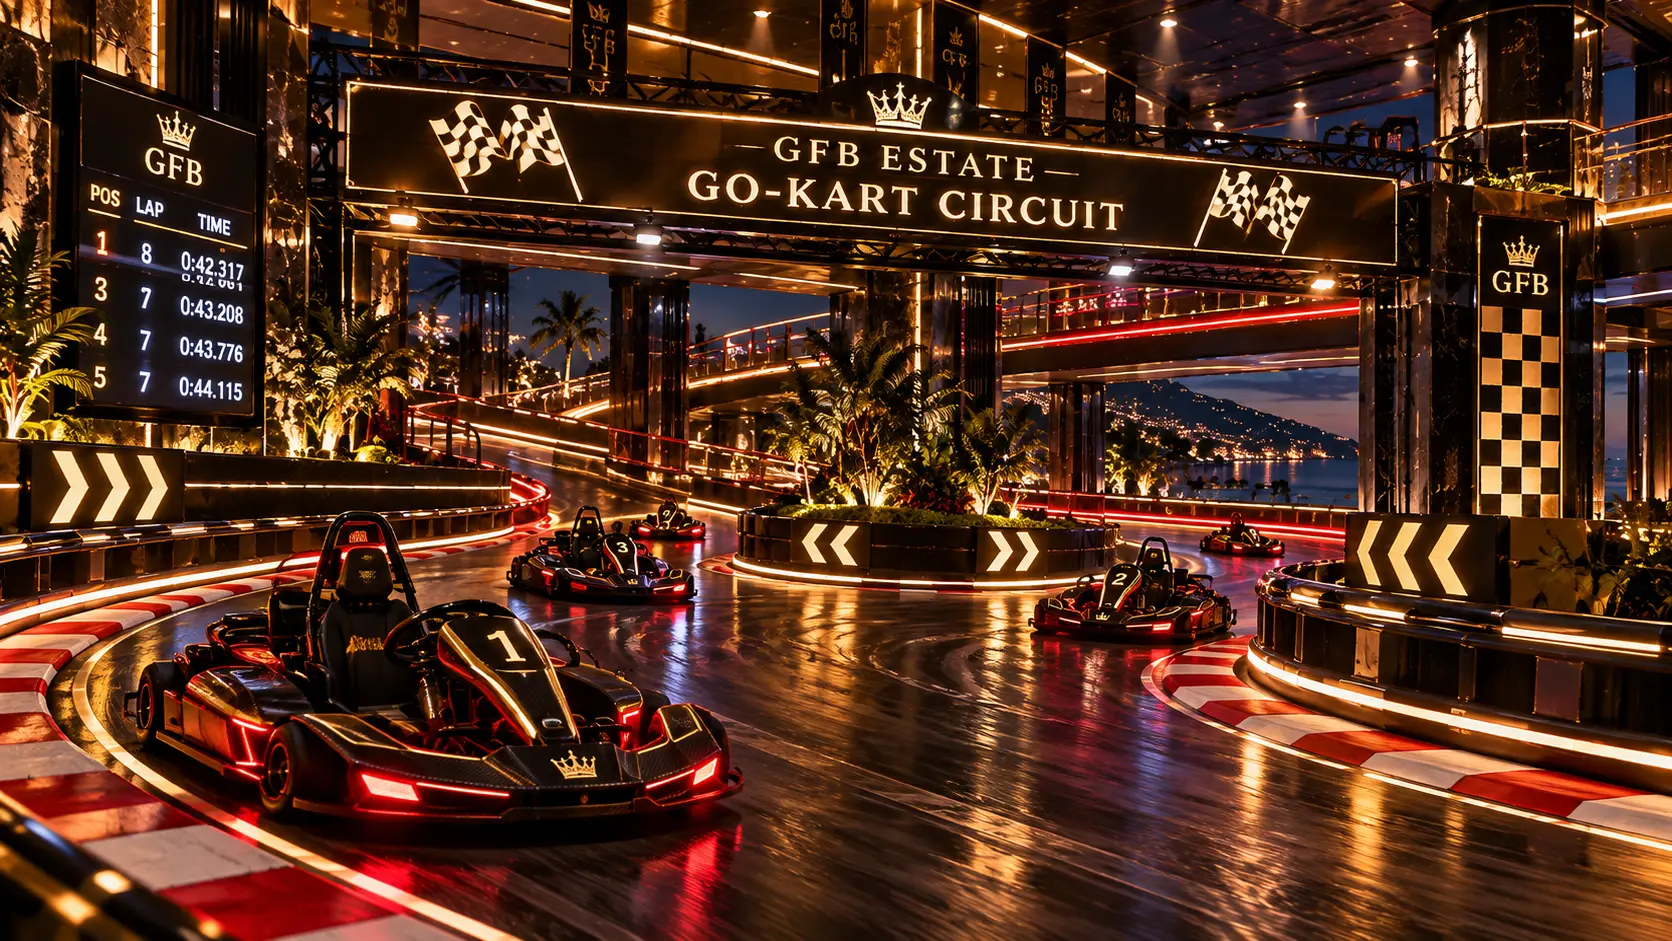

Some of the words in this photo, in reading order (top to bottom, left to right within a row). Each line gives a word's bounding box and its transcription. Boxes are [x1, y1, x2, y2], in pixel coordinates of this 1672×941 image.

[145, 147, 203, 187] GFB
[774, 136, 860, 167] GFB
[881, 144, 1035, 182] ESTATE
[90, 183, 120, 207] POS
[136, 196, 164, 218] LAP
[197, 212, 231, 236] TIME
[687, 169, 919, 216] GO-KART
[938, 189, 1124, 231] CIRCUIT
[96, 231, 108, 256] 1
[141, 242, 153, 265] 8
[181, 251, 244, 281] 0:42.317
[94, 276, 108, 301] 3
[140, 286, 152, 309] 7
[180, 295, 244, 324] 0:43.208
[1492, 270, 1549, 296] GFB
[93, 322, 108, 346] 4
[139, 329, 152, 351] 7
[179, 336, 243, 363] 0:43.776
[93, 366, 107, 389] 5
[139, 371, 151, 393] 7
[179, 376, 243, 401] 0:44.115
[616, 541, 629, 554] 3
[1111, 572, 1128, 586] 2
[486, 630, 526, 663] 1
